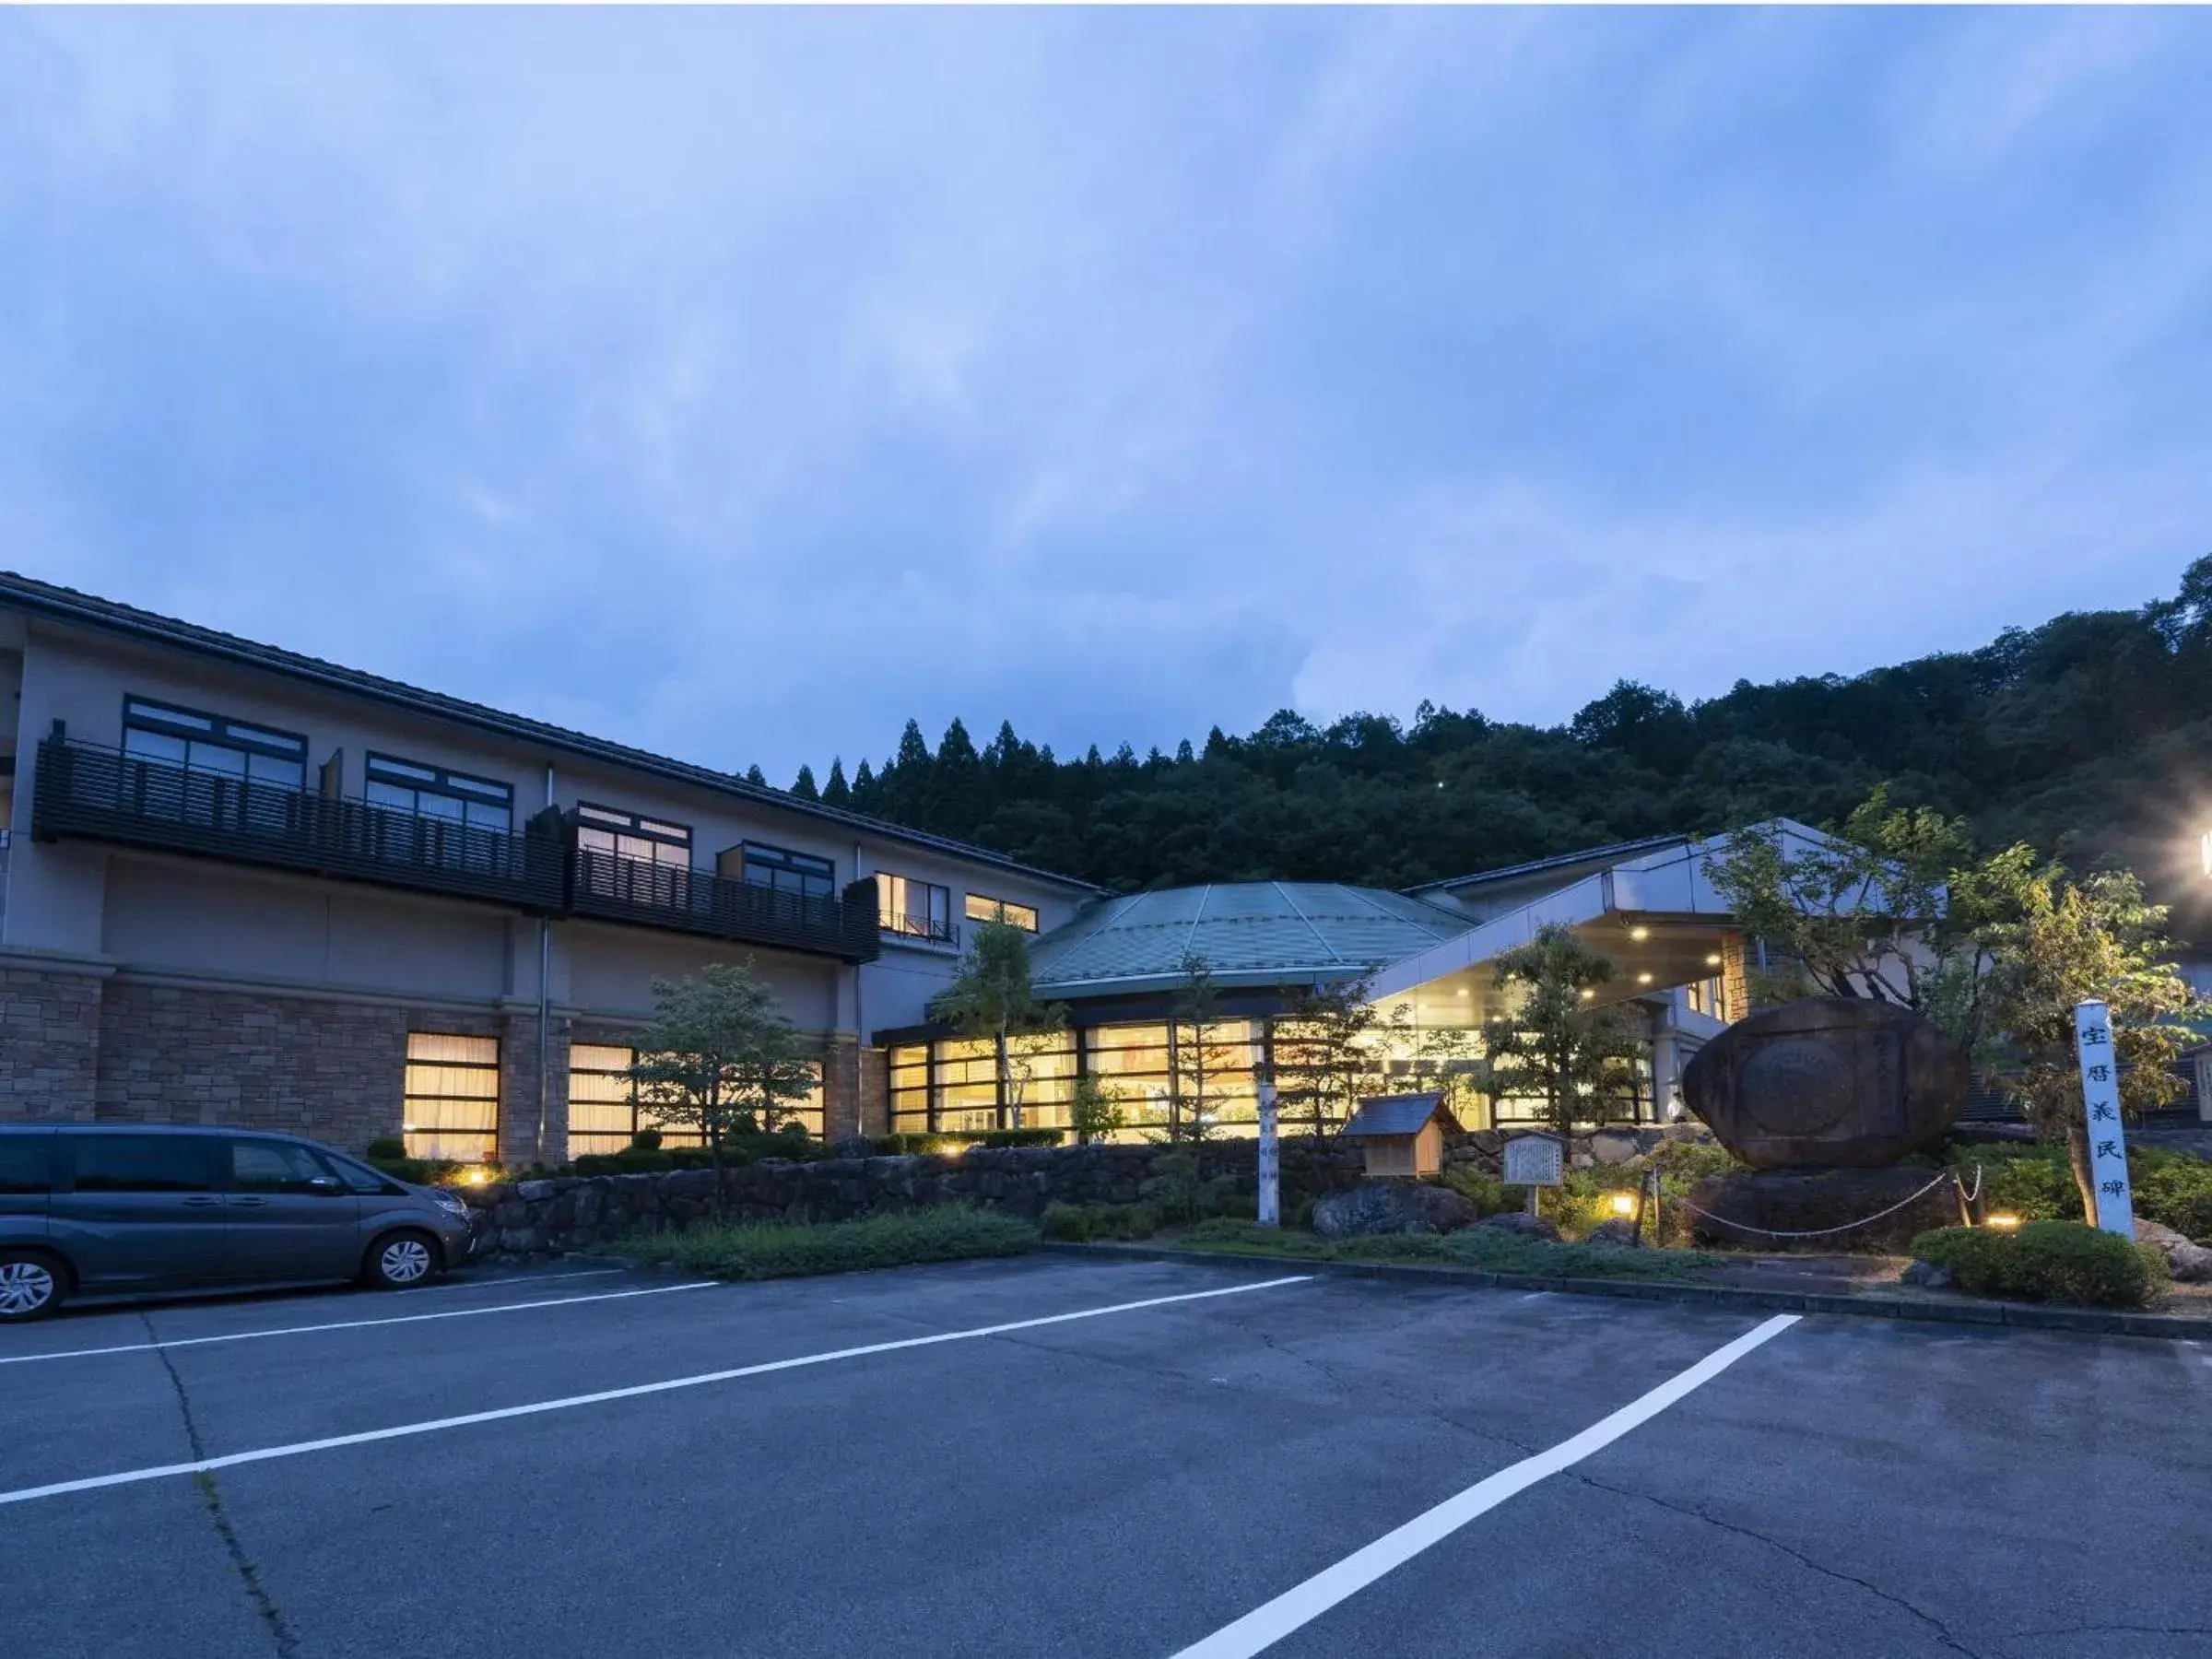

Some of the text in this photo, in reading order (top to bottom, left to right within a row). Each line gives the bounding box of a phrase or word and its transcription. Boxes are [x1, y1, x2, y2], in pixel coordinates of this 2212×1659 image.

[2081, 1026, 2124, 1197] 宝暦義民碑
